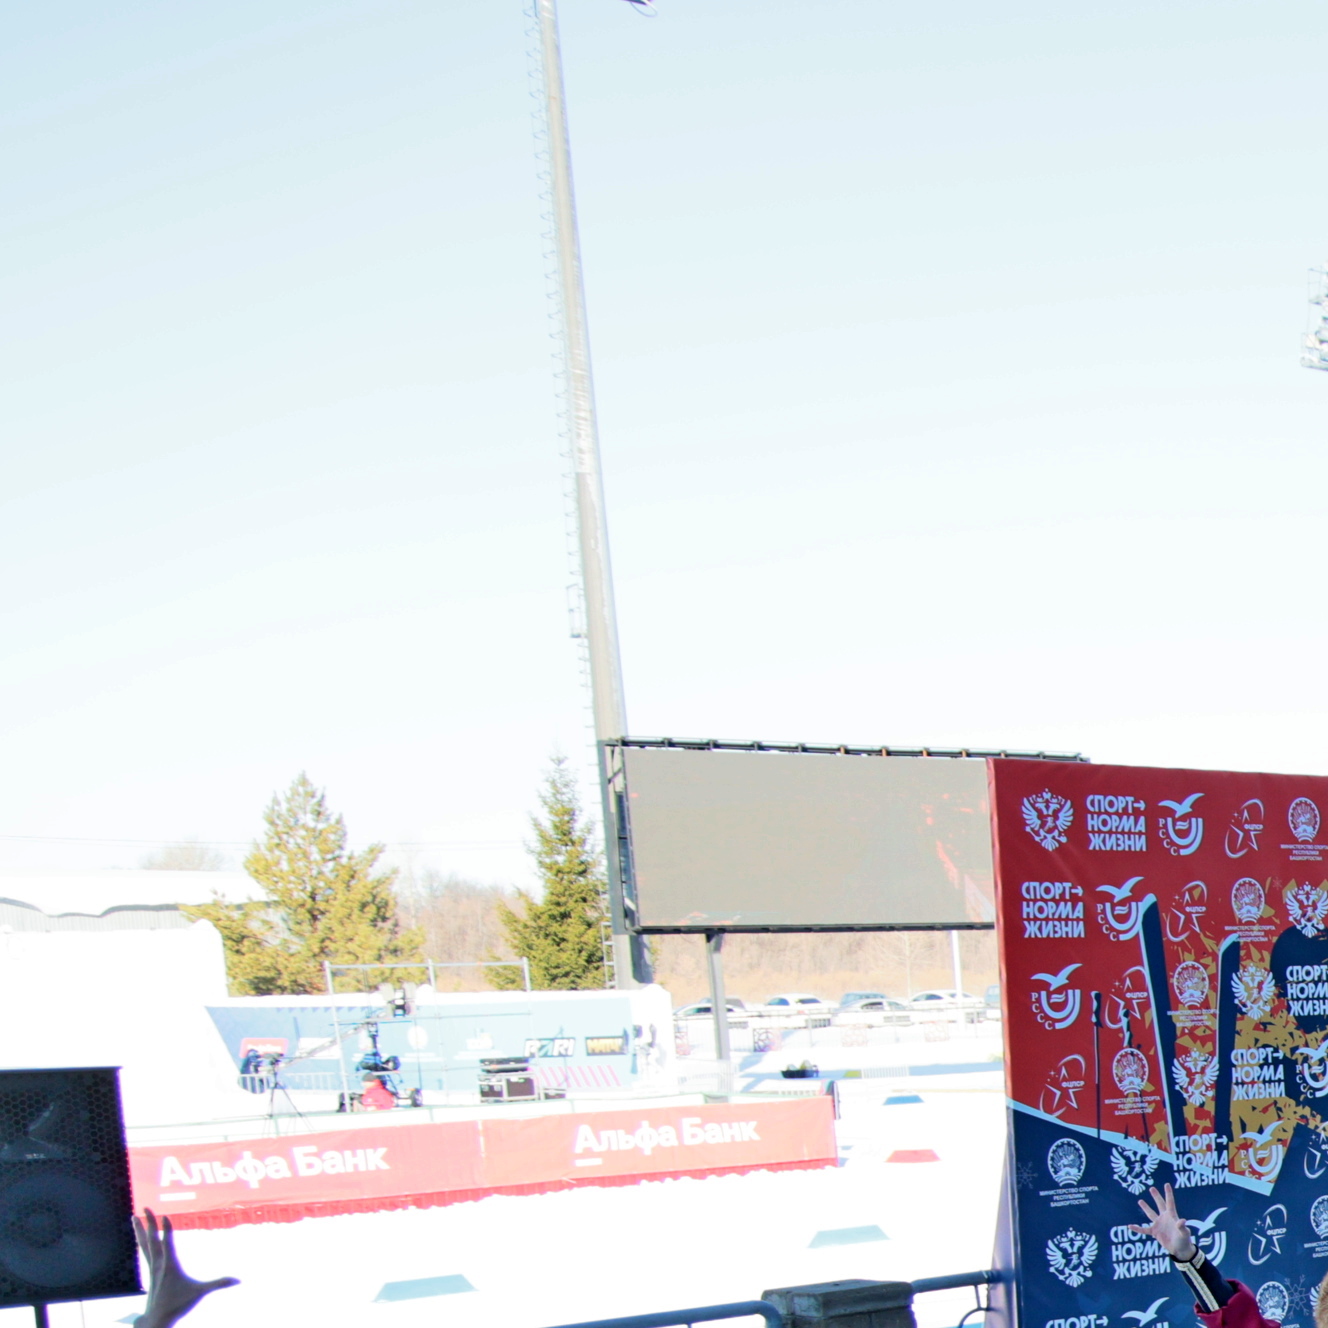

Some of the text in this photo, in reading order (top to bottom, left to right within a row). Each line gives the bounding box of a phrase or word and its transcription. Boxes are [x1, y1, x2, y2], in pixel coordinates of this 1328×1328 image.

[1086, 794, 1134, 813] СПОРТ
[1086, 814, 1146, 832] НОРМА
[1088, 833, 1147, 852] ЖИЗНИ
[1021, 882, 1072, 900] СПОРТ
[1022, 901, 1084, 919] НОРМА
[1024, 920, 1085, 938] ЖИЗНИ
[1286, 965, 1328, 982] СПОРТ
[1230, 1048, 1274, 1065] СПОРТ
[1231, 1065, 1285, 1083] НОРМА
[1233, 1082, 1286, 1100] ЖИЗНИ
[574, 1117, 760, 1154] Альфа Банк
[1173, 1134, 1217, 1151] СПОРТ
[160, 1146, 391, 1188] Альфа Банк
[1173, 1150, 1228, 1170] НОРМА
[1174, 1167, 1229, 1189] ЖИЗНИ
[1113, 1257, 1171, 1280] ЖИЗНИ
